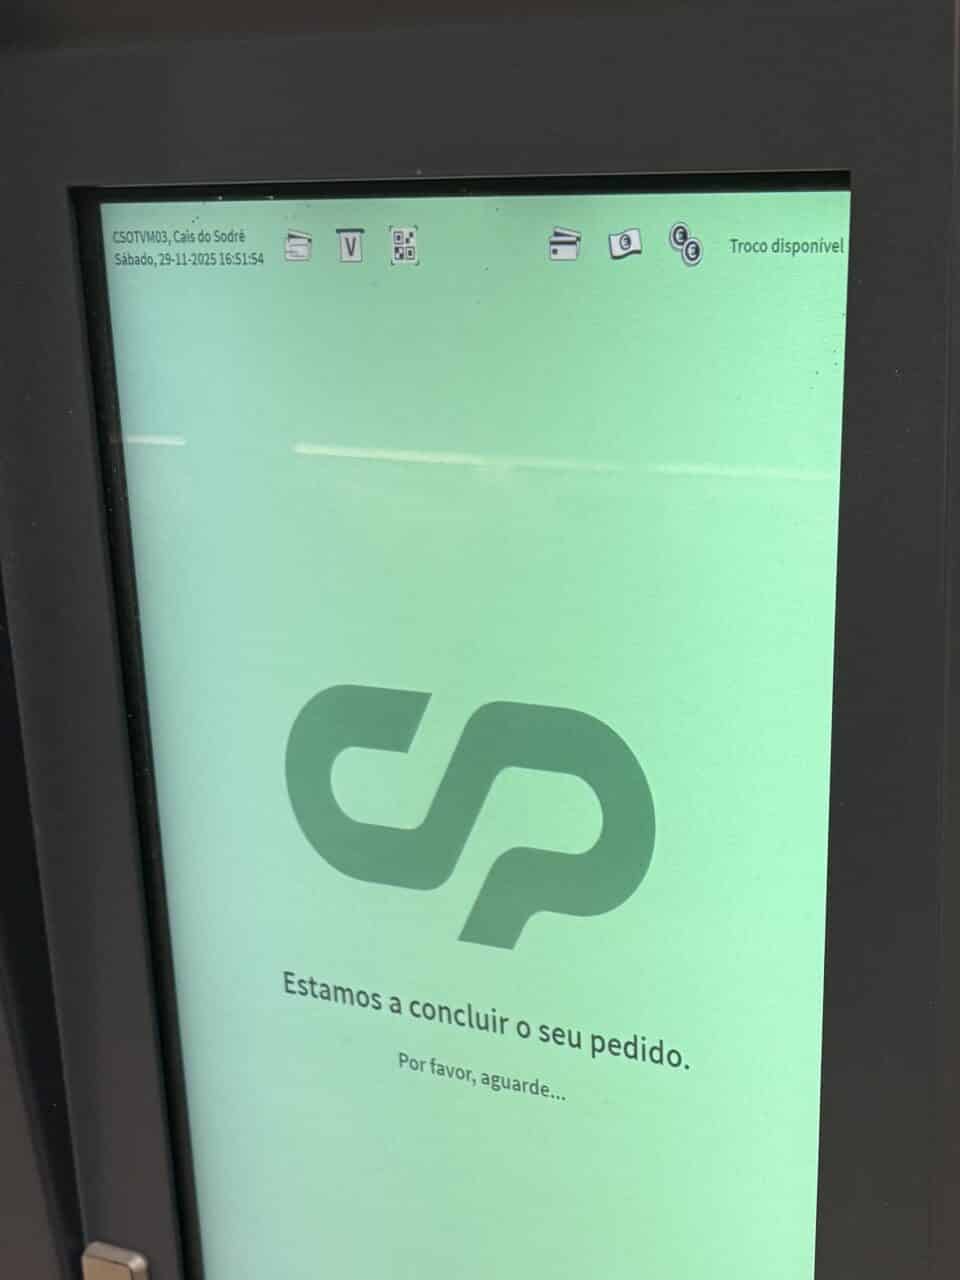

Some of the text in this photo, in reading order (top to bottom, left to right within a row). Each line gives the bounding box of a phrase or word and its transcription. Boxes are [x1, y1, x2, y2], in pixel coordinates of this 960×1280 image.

[173, 230, 195, 243] Cais
[197, 230, 211, 243] do
[730, 237, 845, 256] Troco disponível
[159, 252, 217, 266] 29-11-2025
[219, 252, 264, 266] 16:51:54
[283, 970, 690, 1070] Estamos a concluir o seu pedido.
[398, 1051, 566, 1101] Por favor, aguarde...
